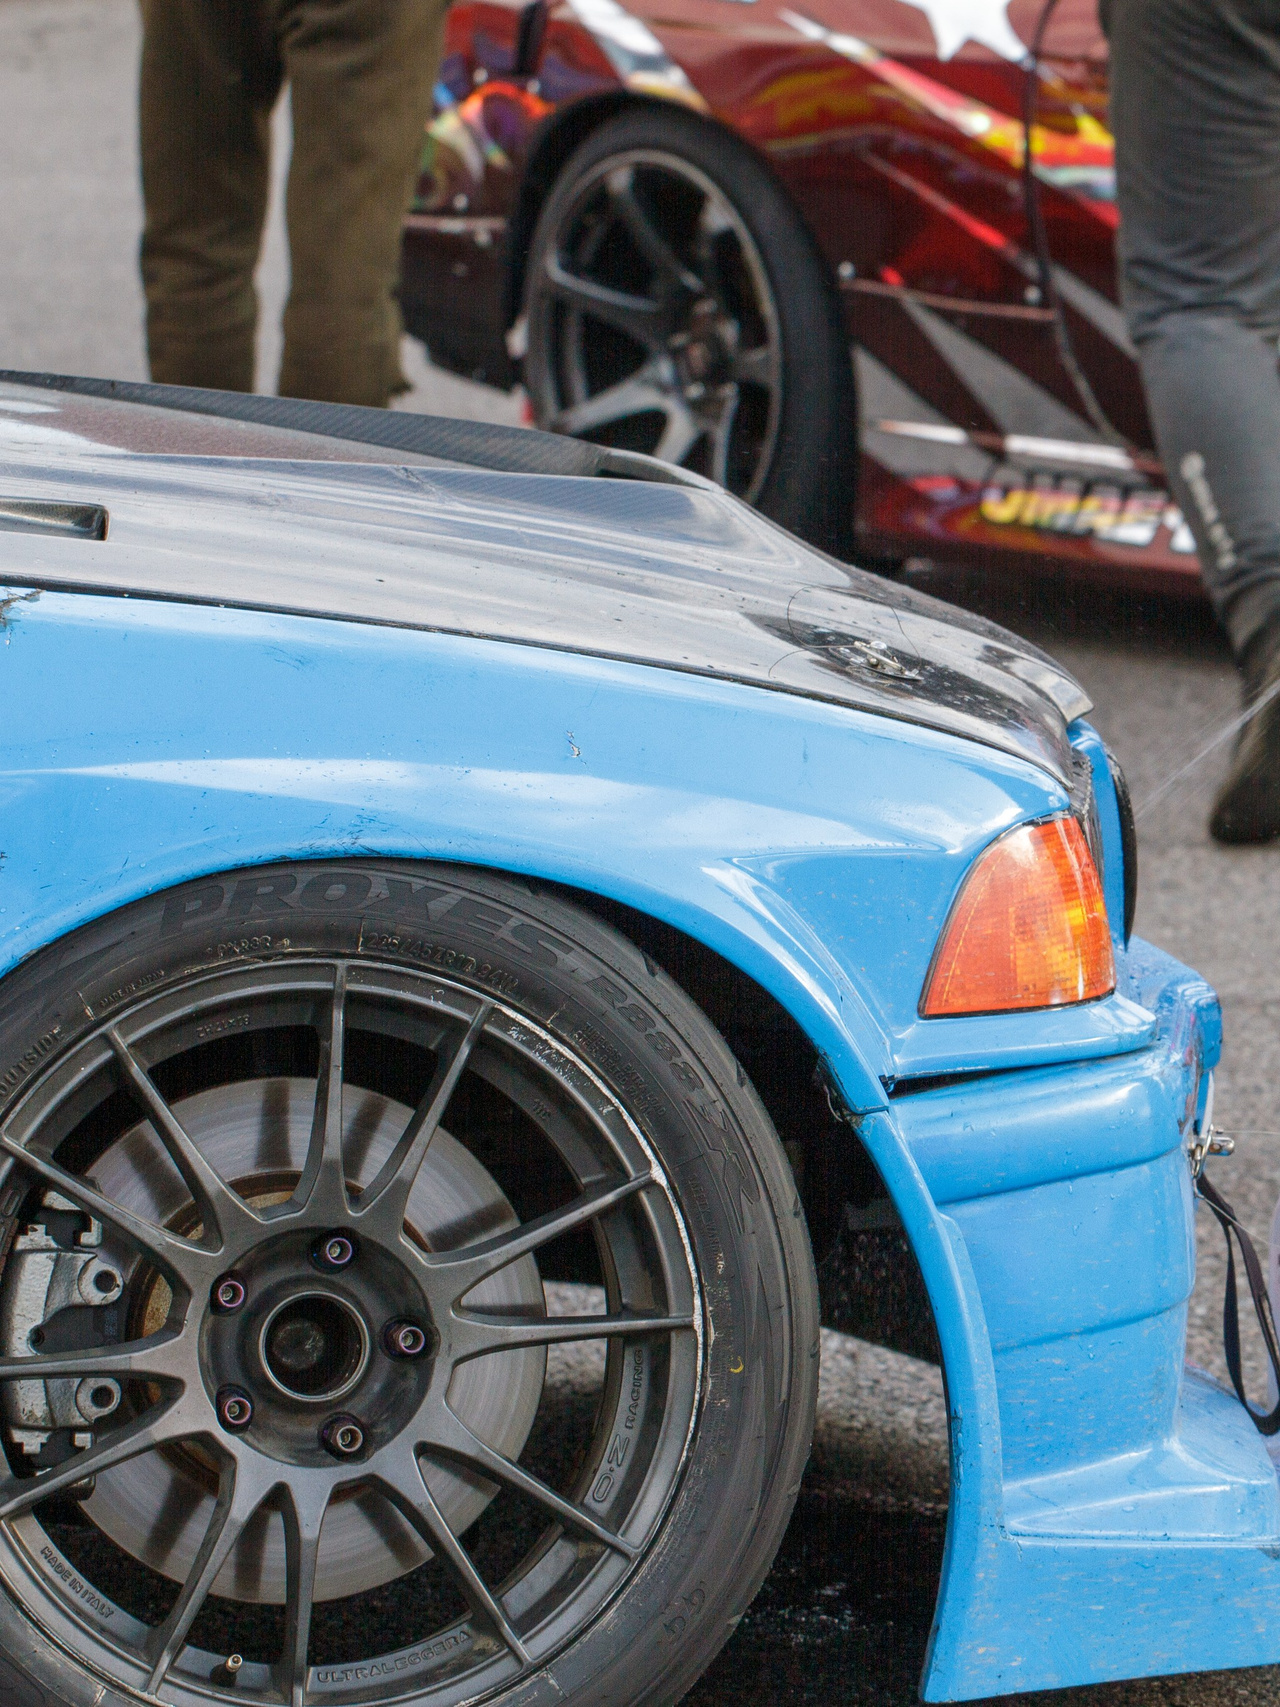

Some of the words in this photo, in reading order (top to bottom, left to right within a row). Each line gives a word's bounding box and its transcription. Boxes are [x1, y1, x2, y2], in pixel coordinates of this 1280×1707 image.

[160, 873, 575, 968] PROXES
[0, 1024, 61, 1096] OUTSIDE
[625, 1349, 644, 1430] RACING
[40, 1546, 73, 1582] MADE
[69, 1577, 84, 1594] IN
[80, 1589, 115, 1619] ITALY
[317, 1630, 471, 1683] ULTRALEGGERA
